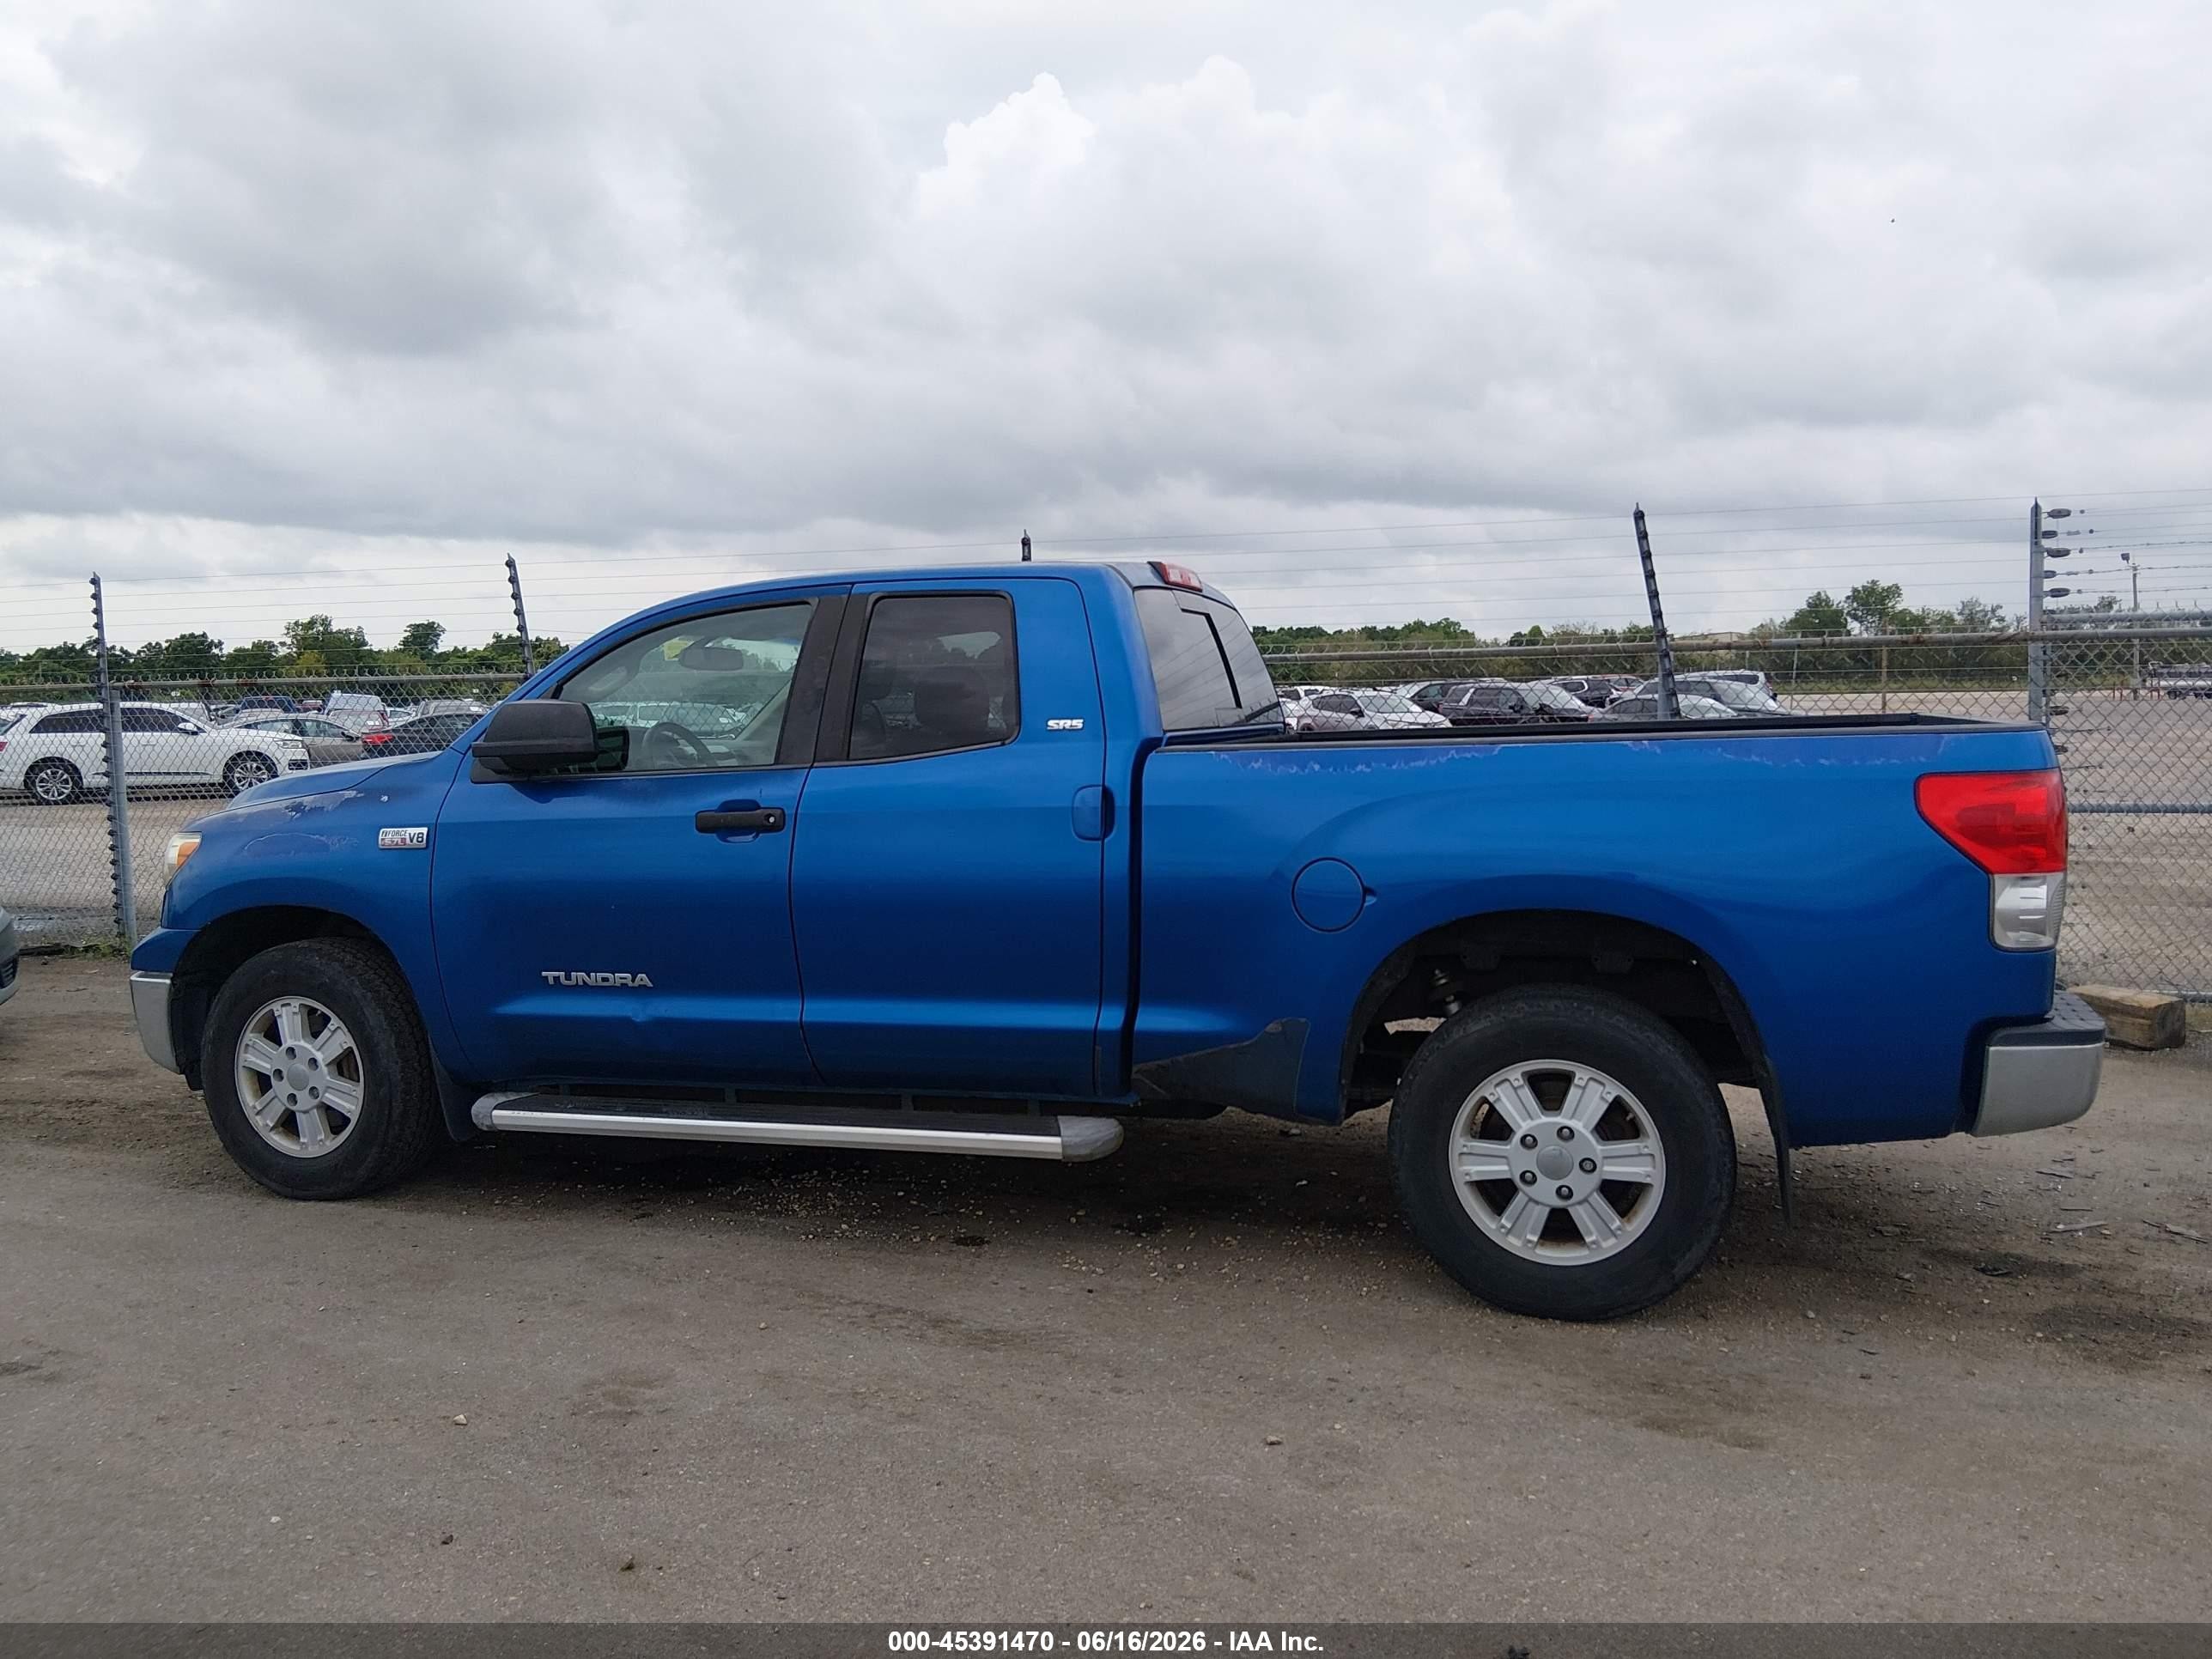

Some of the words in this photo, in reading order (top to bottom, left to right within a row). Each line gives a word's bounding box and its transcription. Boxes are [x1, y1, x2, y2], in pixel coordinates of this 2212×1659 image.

[1047, 719, 1084, 730] SR5
[408, 831, 425, 843] V8
[541, 971, 653, 988] TUNDRA
